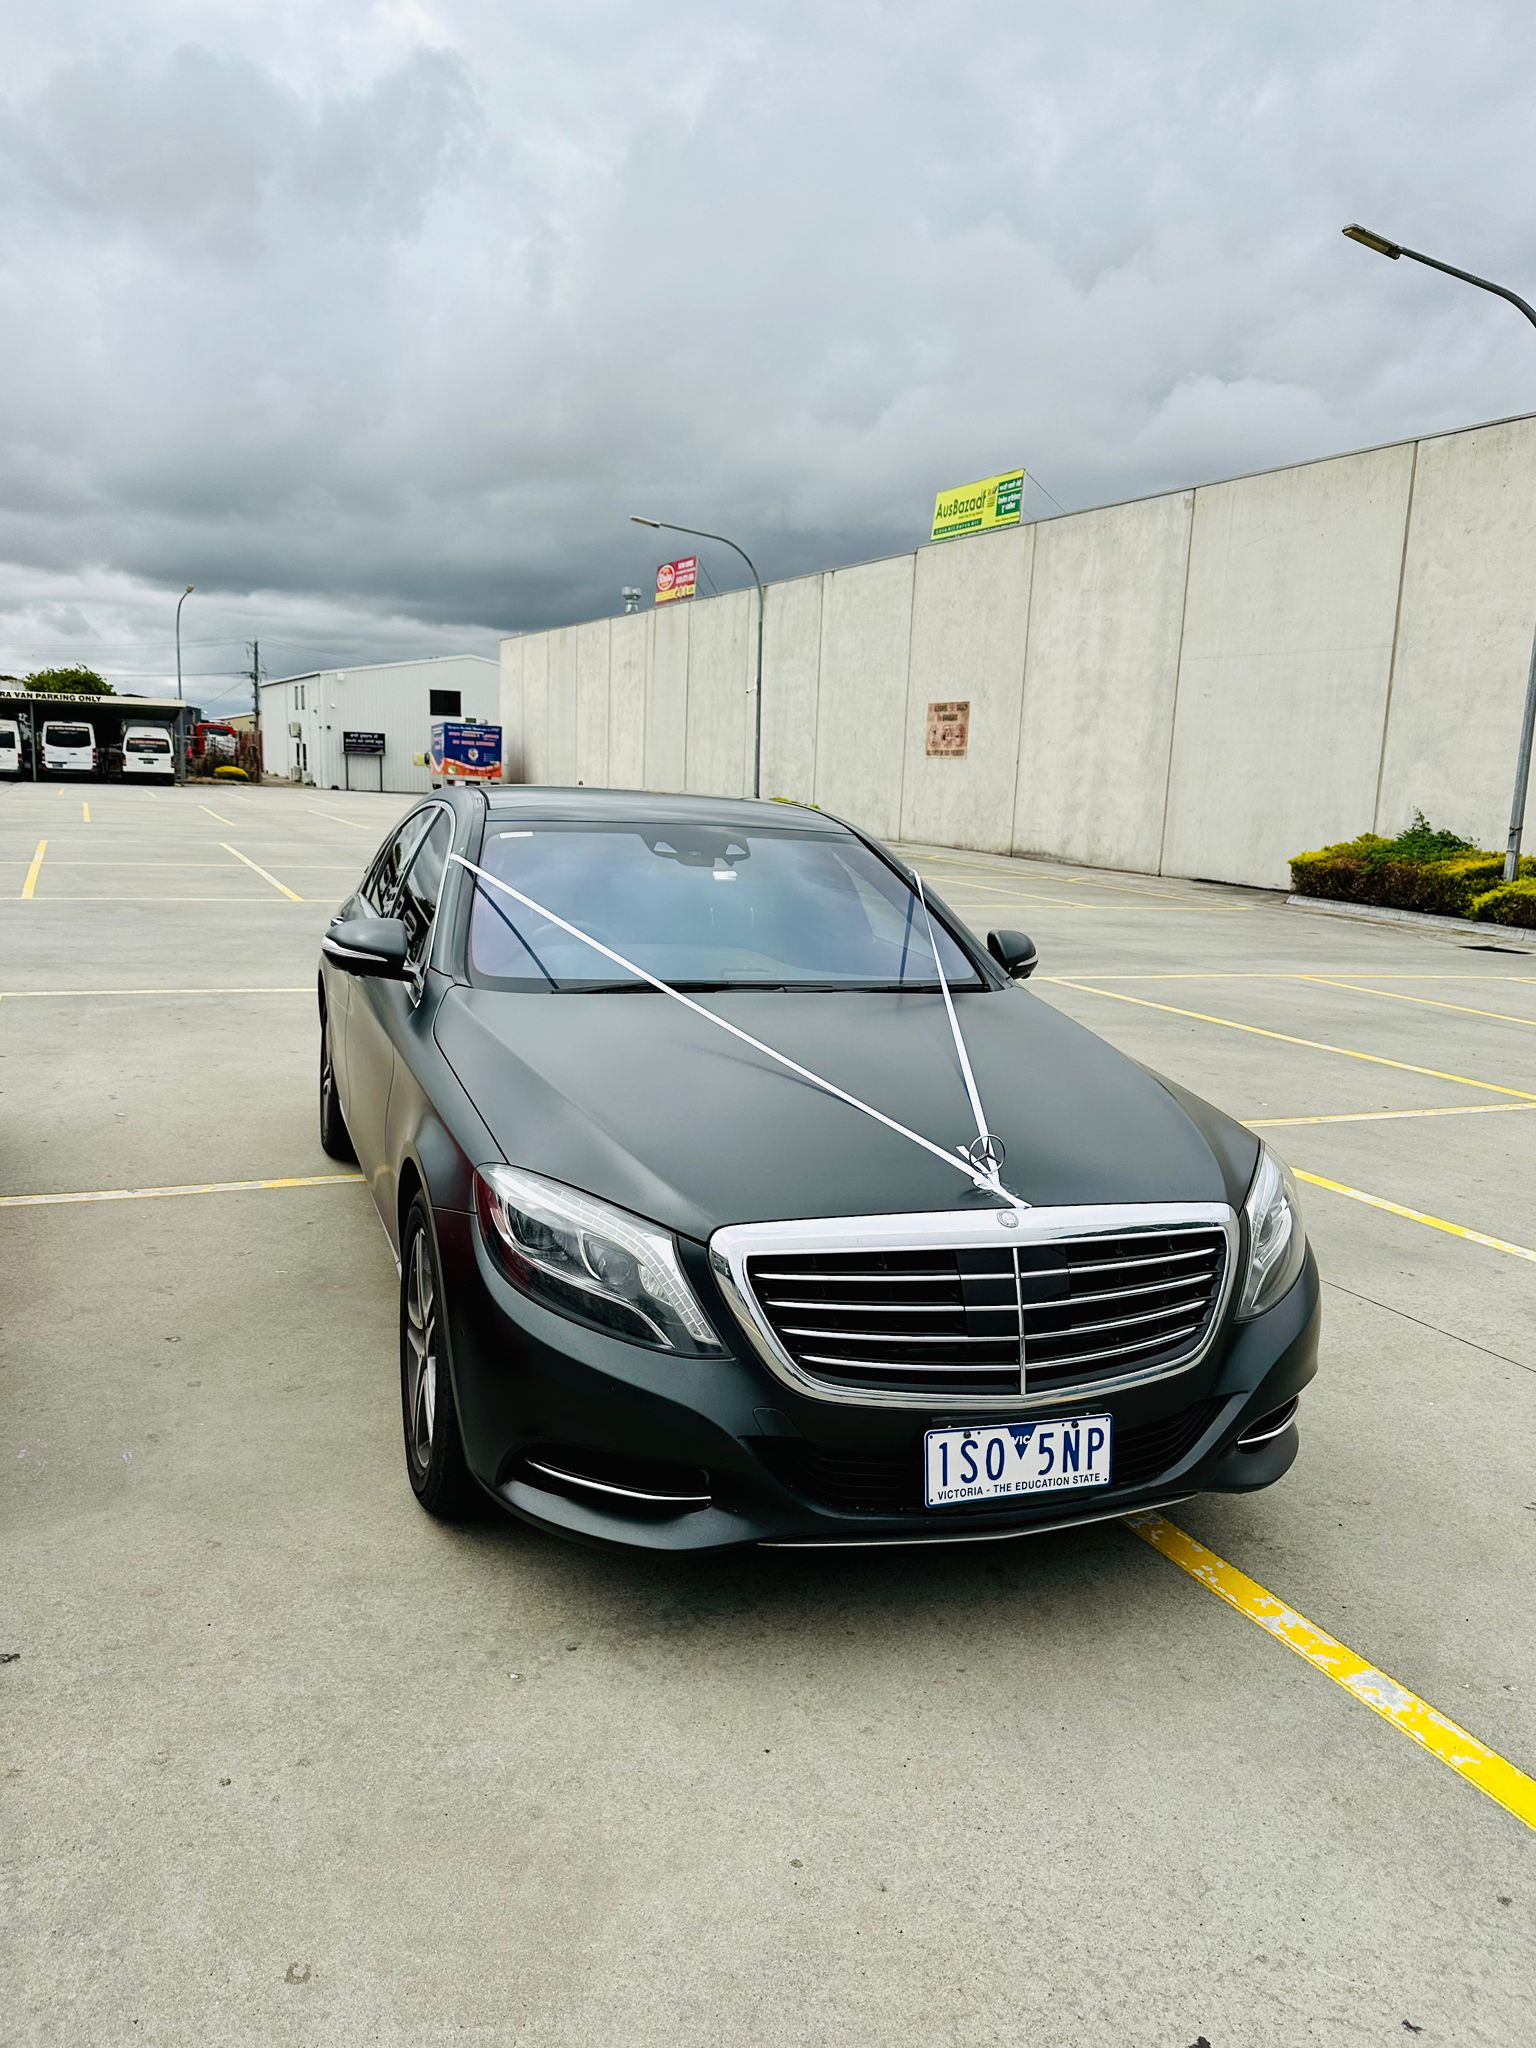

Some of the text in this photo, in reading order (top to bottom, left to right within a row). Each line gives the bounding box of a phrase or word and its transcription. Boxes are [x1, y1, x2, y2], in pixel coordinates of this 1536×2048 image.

[14, 691, 33, 699] VAN
[35, 693, 76, 701] PARKING
[78, 694, 101, 702] ONLY
[1012, 1434, 1031, 1446] VIC
[938, 1427, 1105, 1487] 1SO 5NP
[938, 1486, 983, 1500] VICTORIA
[993, 1483, 1012, 1494] THE
[1015, 1476, 1071, 1491] EDUCATION
[1072, 1473, 1100, 1485] STATE
